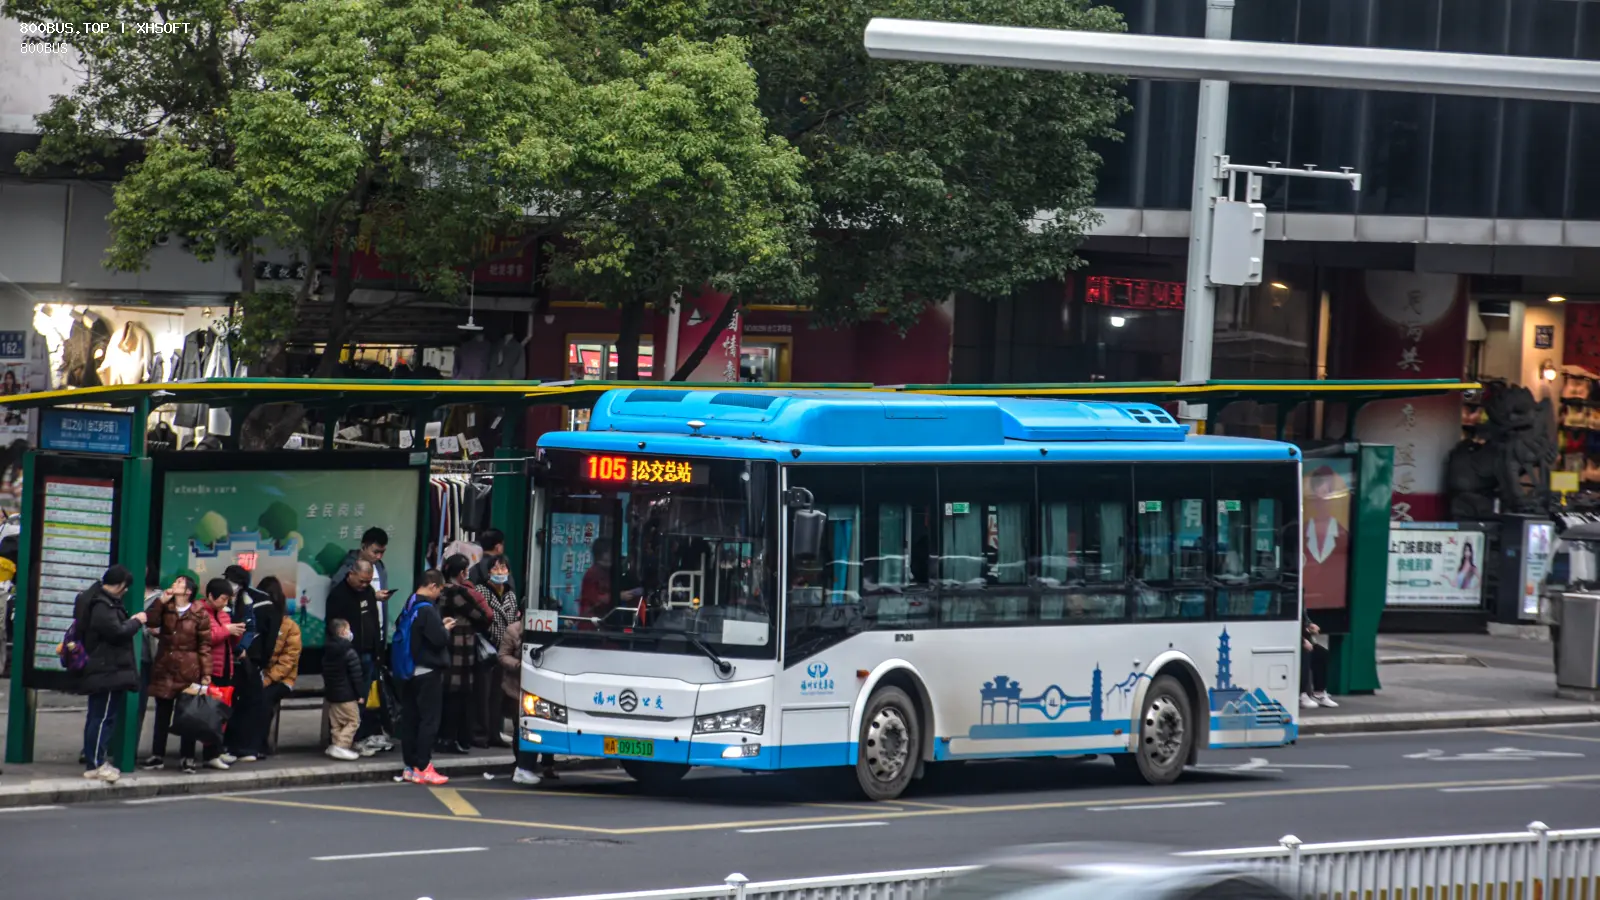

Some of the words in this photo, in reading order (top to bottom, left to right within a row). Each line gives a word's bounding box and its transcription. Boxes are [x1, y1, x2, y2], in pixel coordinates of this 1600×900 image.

[588, 456, 628, 480] 105
[306, 502, 366, 518] 全民阅读
[338, 524, 395, 539] 书香会
